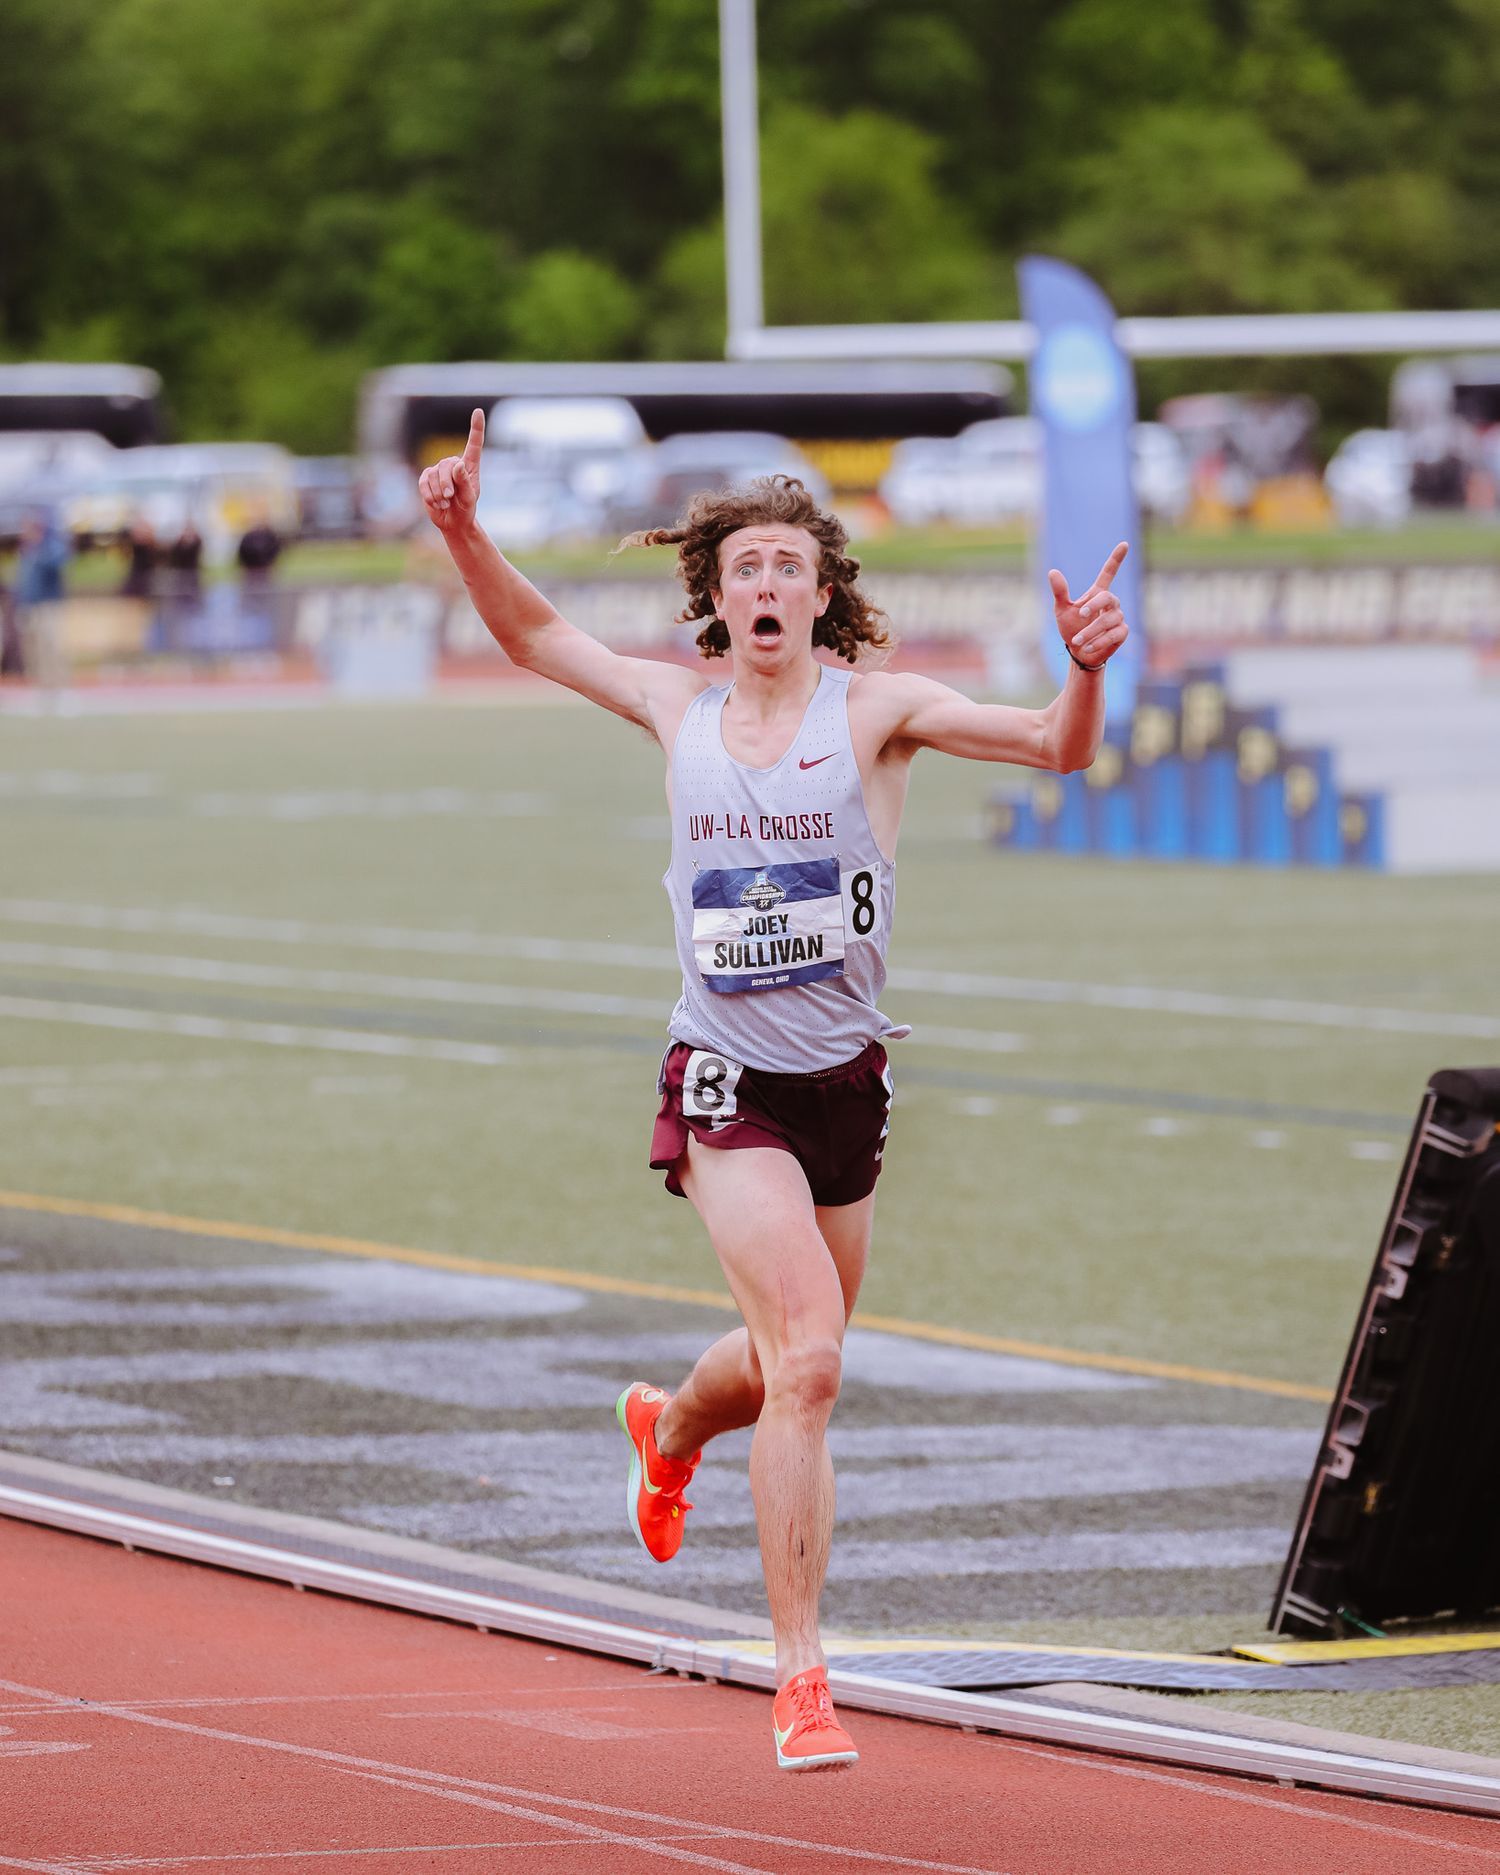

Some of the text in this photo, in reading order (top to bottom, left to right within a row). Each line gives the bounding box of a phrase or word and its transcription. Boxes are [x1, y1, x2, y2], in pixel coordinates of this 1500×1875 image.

[689, 812, 834, 842] UW-LA CROSSE
[742, 891, 785, 902] CHAMPIONSHIPS
[851, 871, 875, 936] 8
[743, 914, 789, 936] JOEY
[713, 934, 823, 969] SULLIVAN
[751, 974, 790, 987] GENEVA, OHIO
[693, 1057, 727, 1111] 8
